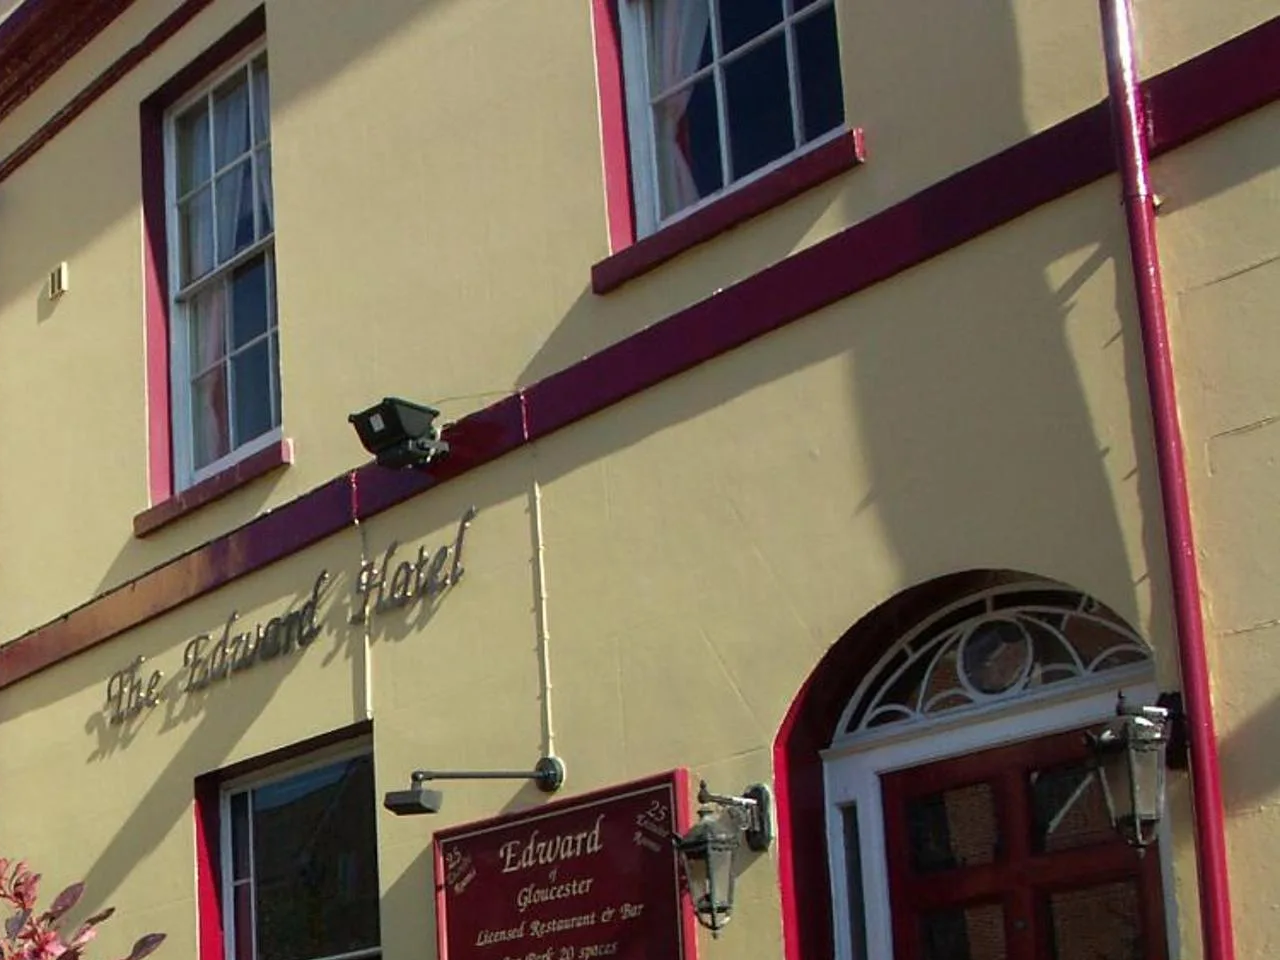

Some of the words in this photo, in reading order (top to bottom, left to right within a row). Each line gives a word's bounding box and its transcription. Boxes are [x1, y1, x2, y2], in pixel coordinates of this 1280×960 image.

[106, 654, 165, 726] The
[183, 569, 330, 694] Edward
[347, 504, 478, 626] Hotel
[499, 813, 606, 873] Edward
[516, 878, 594, 913] Gloucester
[475, 920, 525, 946] Licensed
[529, 912, 596, 938] Restaurant
[601, 906, 616, 923] &
[620, 902, 644, 920] Bar
